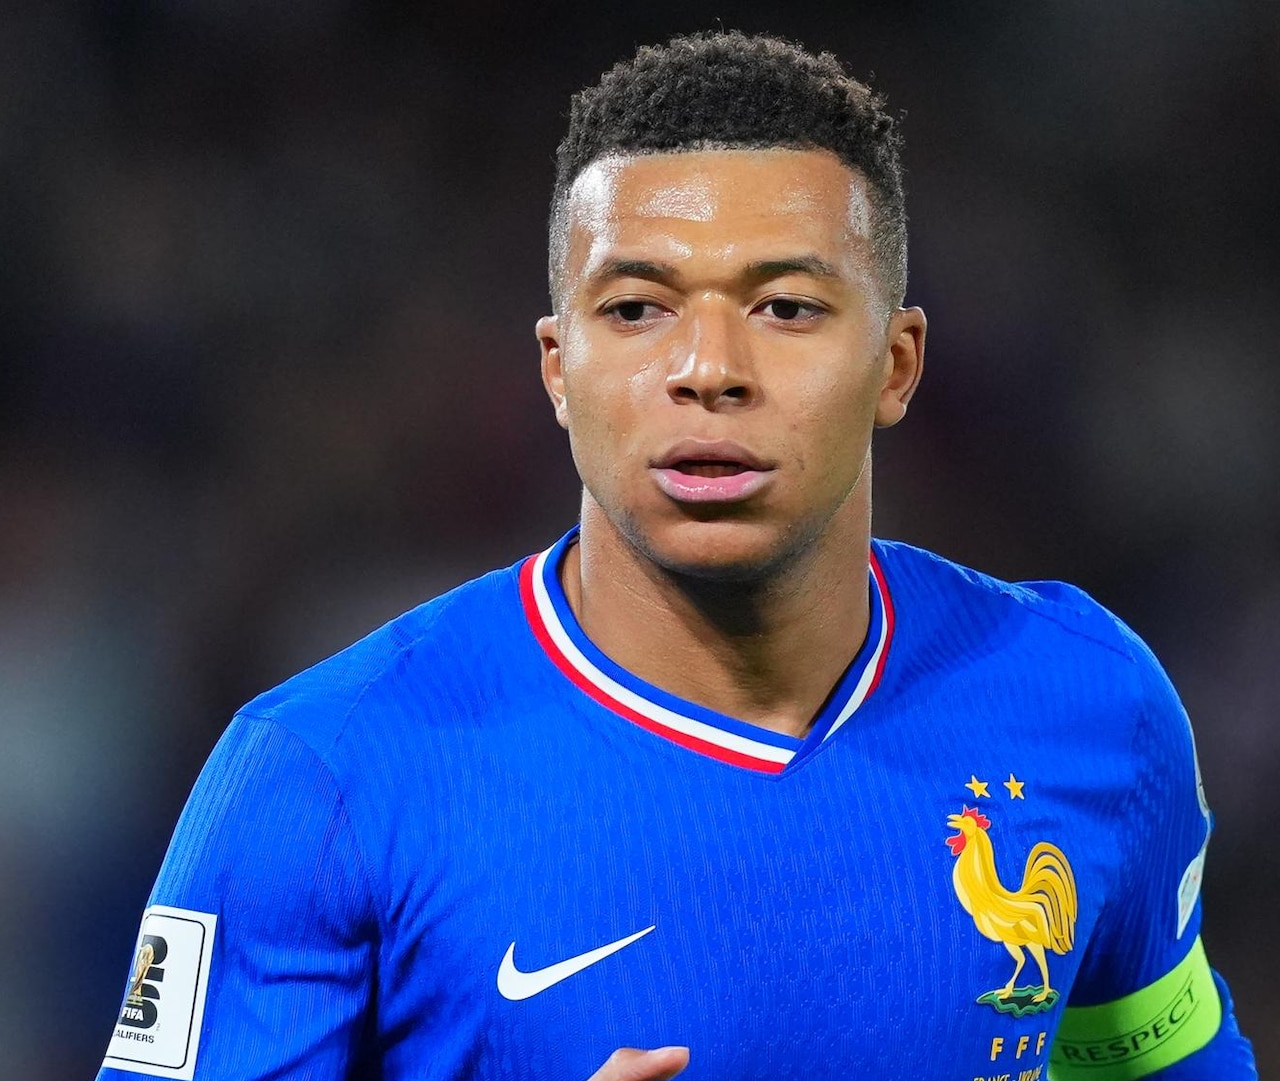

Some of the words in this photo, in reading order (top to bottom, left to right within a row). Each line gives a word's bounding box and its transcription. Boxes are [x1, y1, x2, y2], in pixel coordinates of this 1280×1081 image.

[121, 1006, 144, 1021] FIFA
[1060, 986, 1195, 1062] RESPECT
[114, 1029, 155, 1044] ALIFIERS
